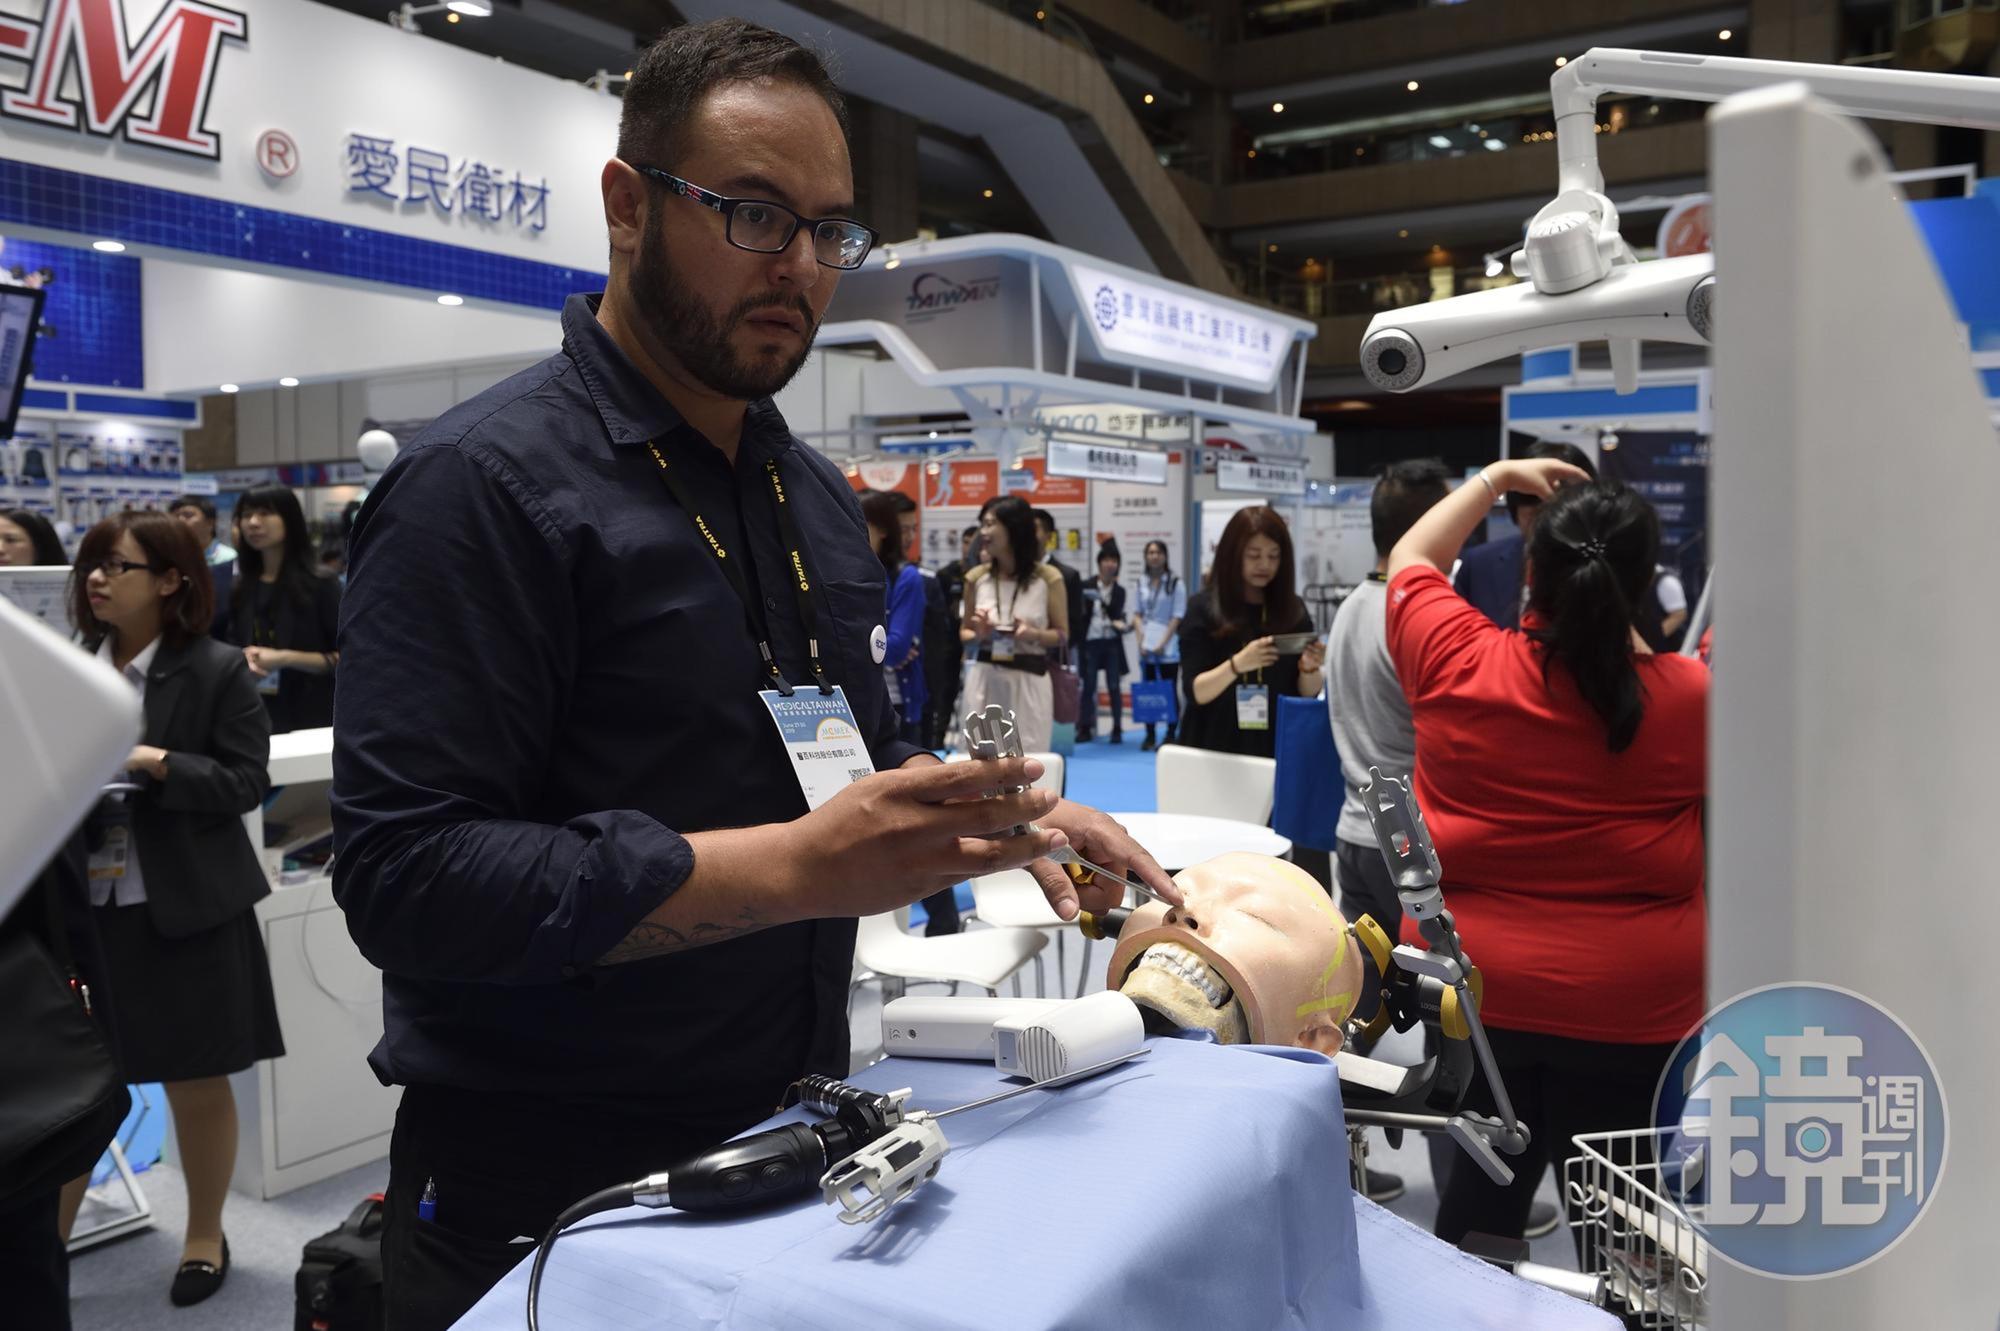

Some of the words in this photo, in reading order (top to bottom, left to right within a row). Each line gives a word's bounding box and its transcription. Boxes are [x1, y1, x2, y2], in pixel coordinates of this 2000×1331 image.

[348, 133, 550, 231] 愛民衛材
[906, 273, 1000, 311] TAIWAN
[695, 515, 720, 551] TAITRA
[791, 550, 808, 582] TAITRA
